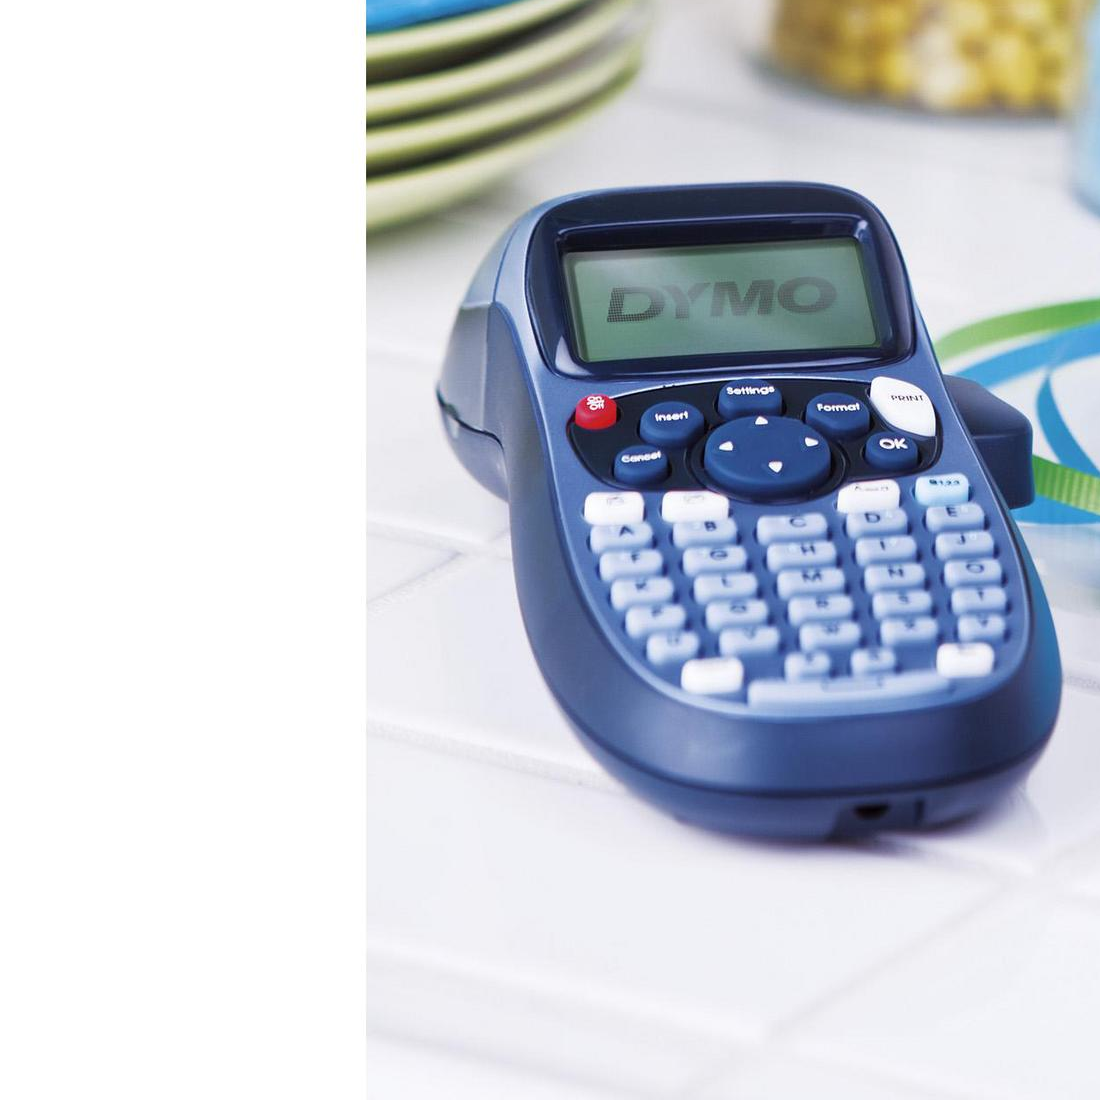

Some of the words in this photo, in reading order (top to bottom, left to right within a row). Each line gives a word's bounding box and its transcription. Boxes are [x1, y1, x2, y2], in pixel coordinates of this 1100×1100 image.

[606, 276, 837, 323] DYMO
[726, 386, 775, 395] Settings
[816, 403, 860, 411] Format
[655, 411, 689, 421] Insert
[879, 437, 908, 450] OK
[621, 450, 662, 463] Cancel
[864, 512, 881, 524] D
[945, 506, 958, 518] E
[703, 520, 717, 532] B
[789, 517, 807, 528] C
[618, 524, 634, 537] A
